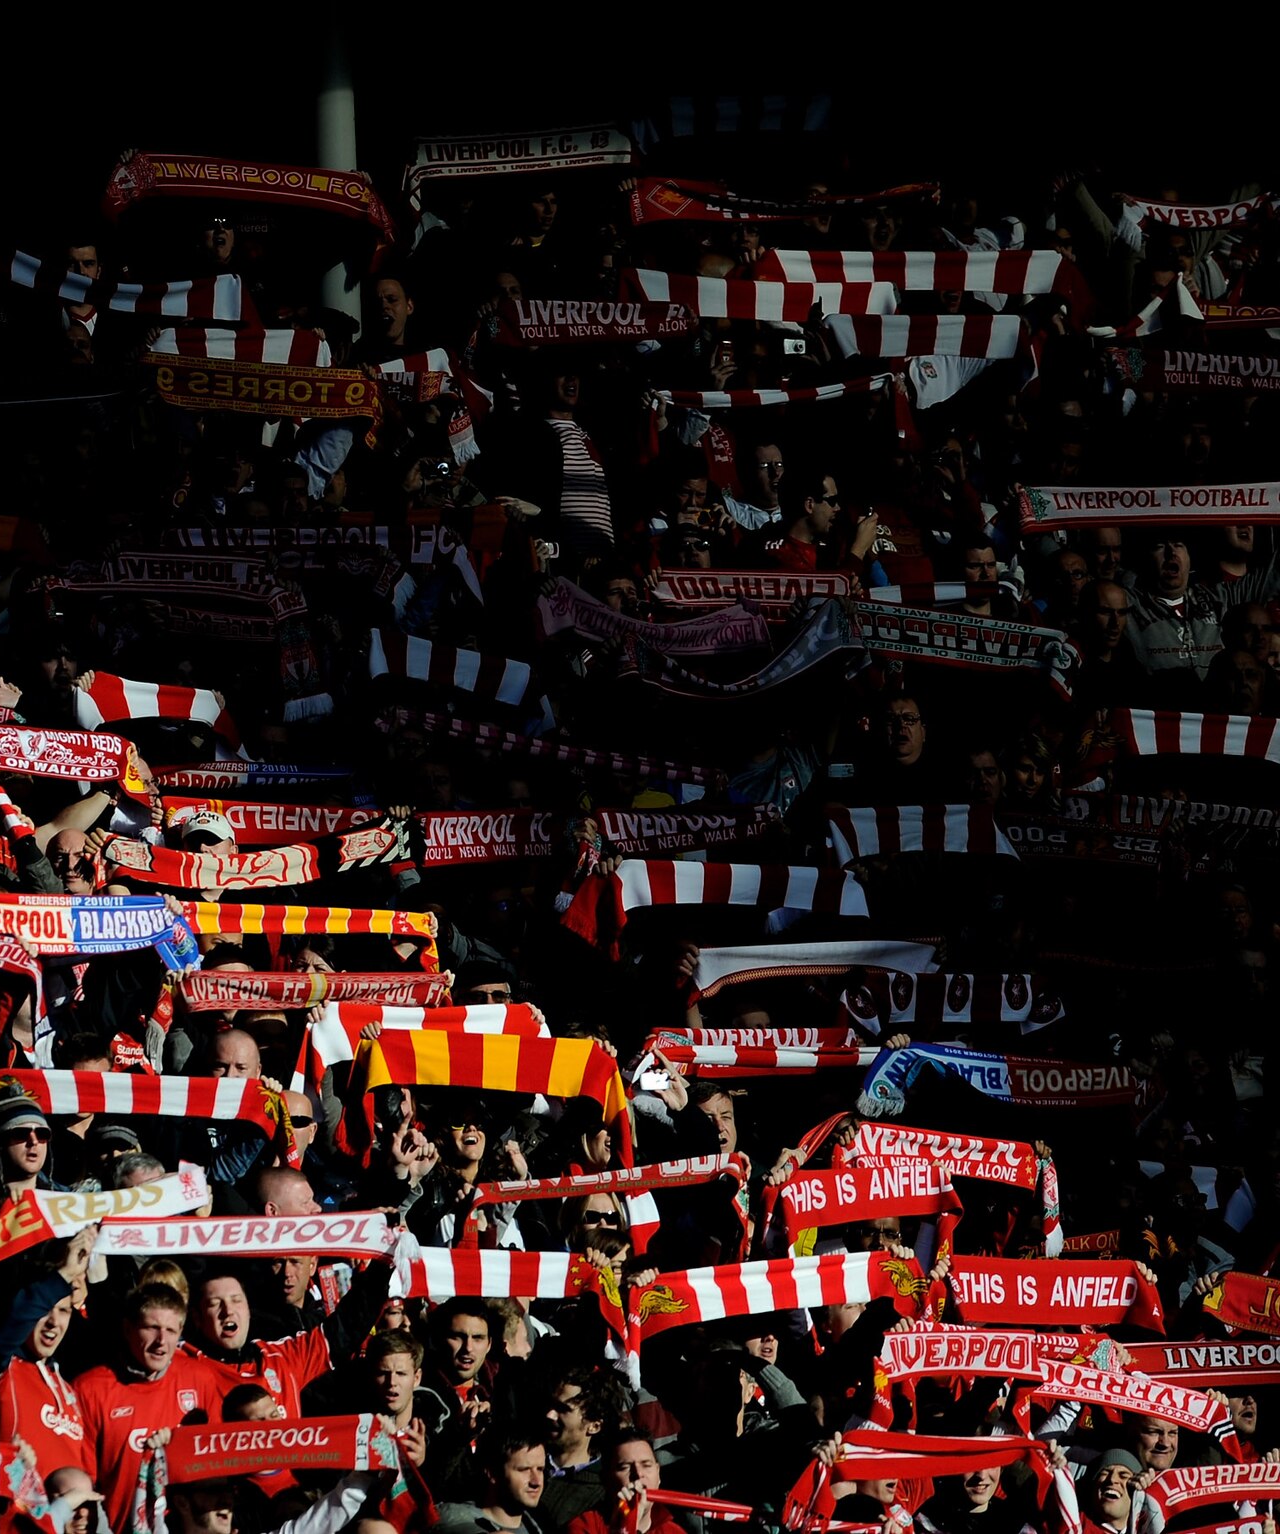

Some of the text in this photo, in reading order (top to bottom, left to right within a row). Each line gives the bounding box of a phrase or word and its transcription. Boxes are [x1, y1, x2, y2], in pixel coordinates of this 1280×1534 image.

[426, 138, 534, 163] LIVERPOOL
[161, 162, 363, 200] LIVERPOOL FC
[515, 300, 646, 325] LIVERPOOL
[520, 320, 688, 338] YOU'LL NEVER WALK ALON
[1164, 372, 1200, 384] YOU'LL
[1208, 374, 1244, 388] NEVER
[1052, 488, 1269, 509] LIVERPOOL FOOTBALL
[660, 577, 835, 600] LIVERPOOL
[45, 731, 122, 754] MIGHTY REDS
[5, 755, 30, 770] ON
[33, 760, 84, 776] WALK
[86, 765, 114, 778] ON
[199, 763, 259, 772] PREMIERSHIP
[225, 805, 344, 832] ANFIELD
[530, 812, 553, 842] FC
[658, 828, 737, 849] NEVER WALK
[460, 845, 488, 858] NEVER
[493, 844, 518, 856] WALK
[524, 843, 552, 856] ALONE
[18, 896, 124, 906] PREMIERSHIP 2010/11
[79, 908, 174, 939] BLACKBU
[41, 943, 66, 953] ROAD
[82, 942, 125, 953] OCTOBER
[126, 940, 153, 950] 2010
[180, 980, 417, 1003] LIVERPOOL FC LIVERPOOL
[976, 1164, 1017, 1182] ALONE
[45, 1184, 165, 1225] REDS
[781, 1178, 827, 1214] THIS
[835, 1173, 857, 1206] IS
[157, 1218, 369, 1248] LIVERPOOL
[1063, 1231, 1119, 1250] ALK ON
[959, 1272, 1137, 1307] THIS IS ANFIELD
[883, 1336, 1042, 1374] LIVERPOOL
[193, 1427, 329, 1455] LIVERPOOL
[300, 1452, 340, 1464] ALONE
